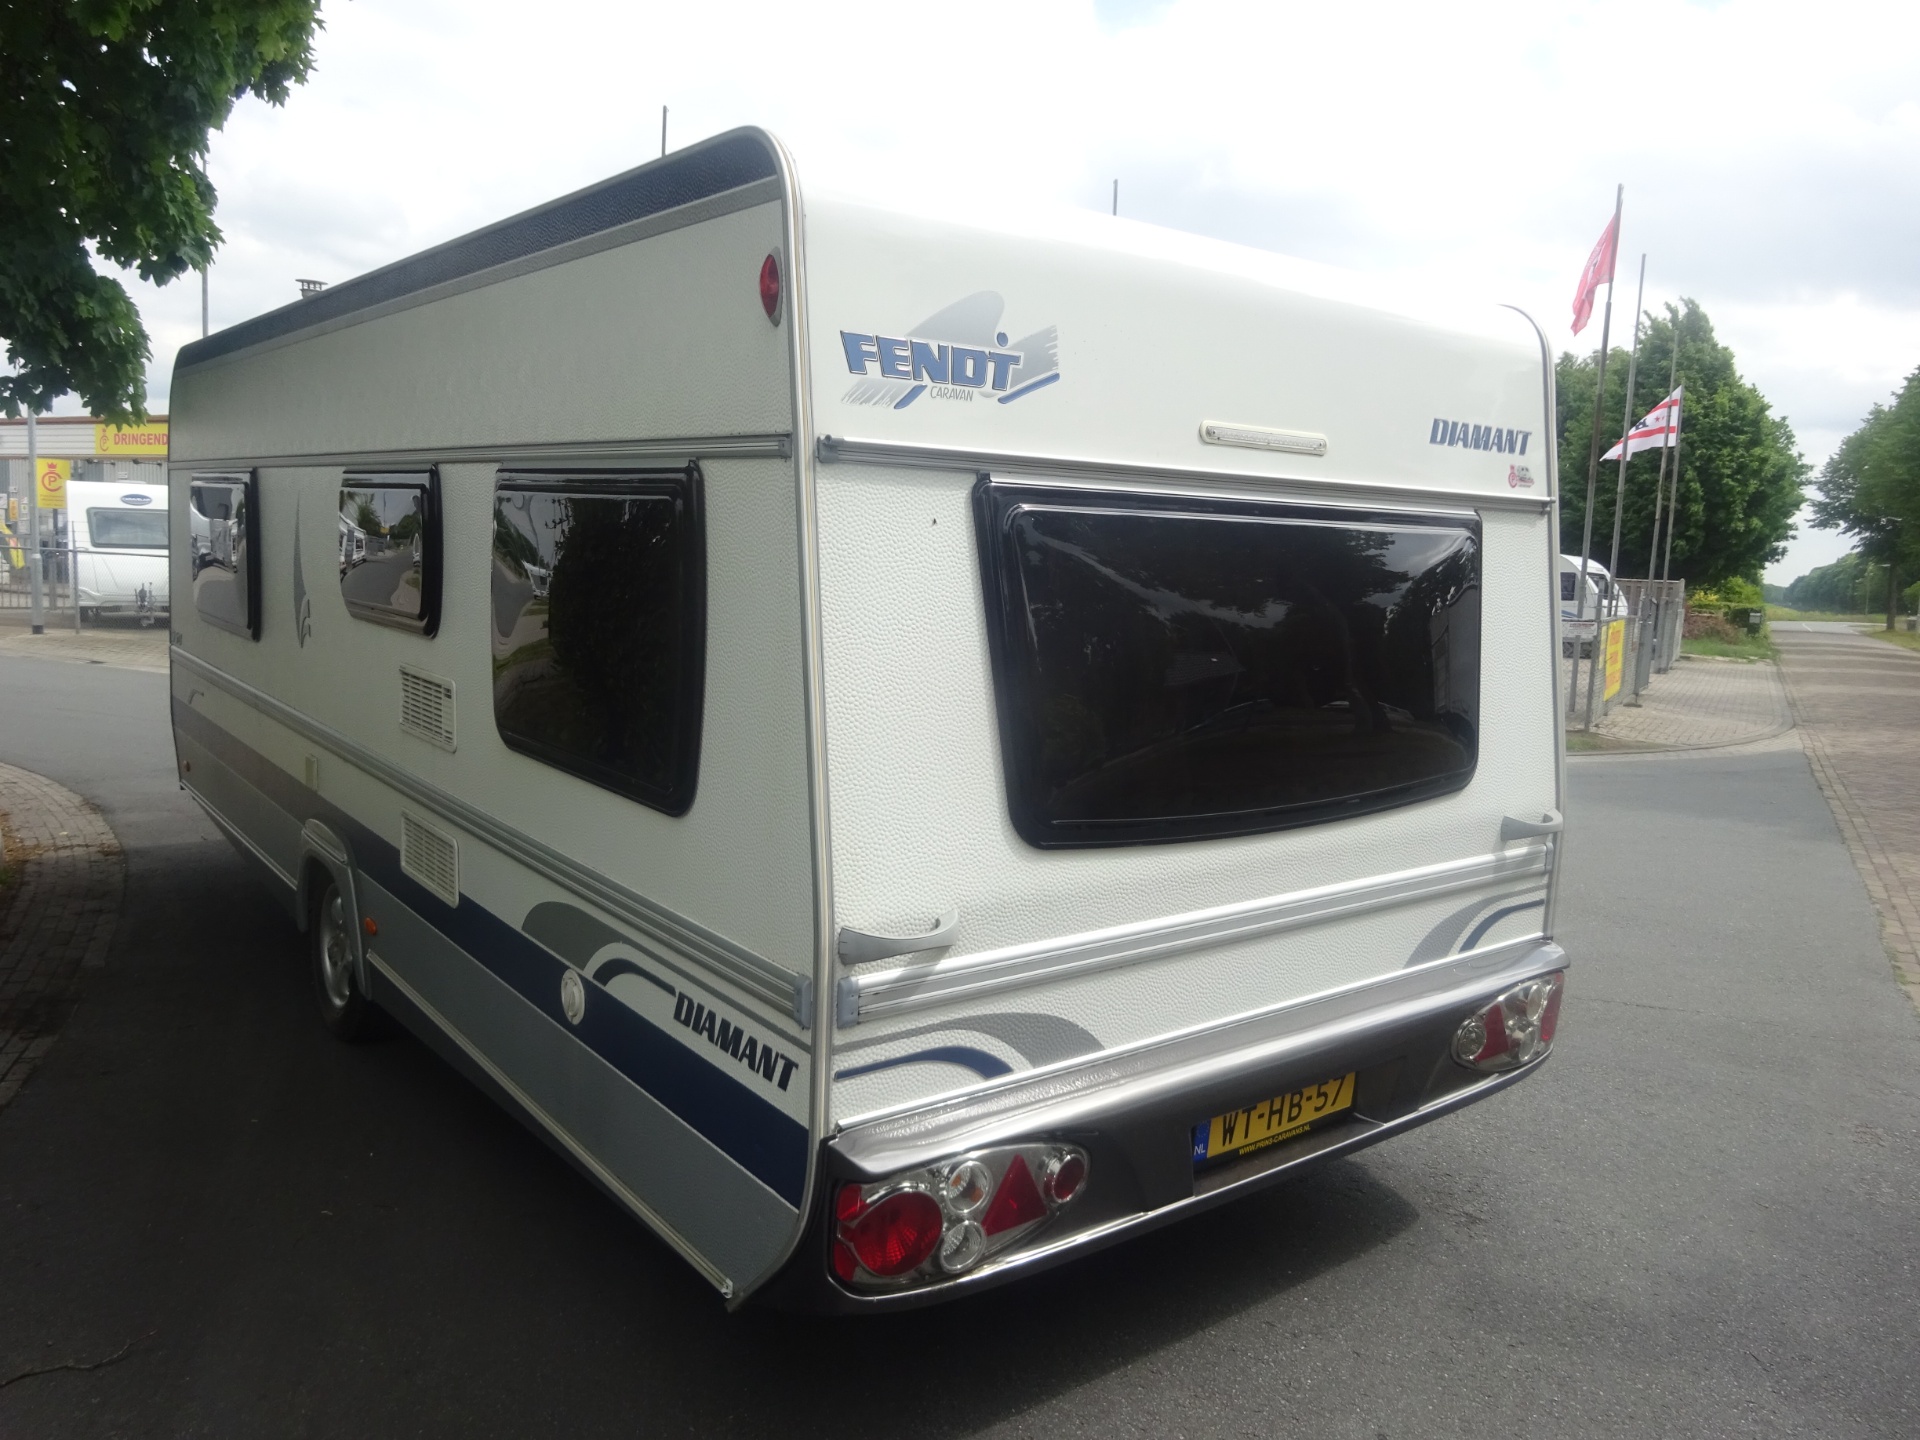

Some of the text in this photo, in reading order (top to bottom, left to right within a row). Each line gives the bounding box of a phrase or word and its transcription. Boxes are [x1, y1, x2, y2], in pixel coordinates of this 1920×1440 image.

[840, 329, 1022, 392] FENDT
[930, 385, 974, 402] CARAVAN
[113, 433, 169, 446] DRINGEND
[1429, 418, 1533, 456] DIAMANT
[673, 991, 799, 1092] DIAMANT
[1222, 1075, 1347, 1147] WT-HB-57
[1193, 1143, 1206, 1156] NL
[1238, 1123, 1312, 1156] WWW.PRINS-CARAVANS.NL
